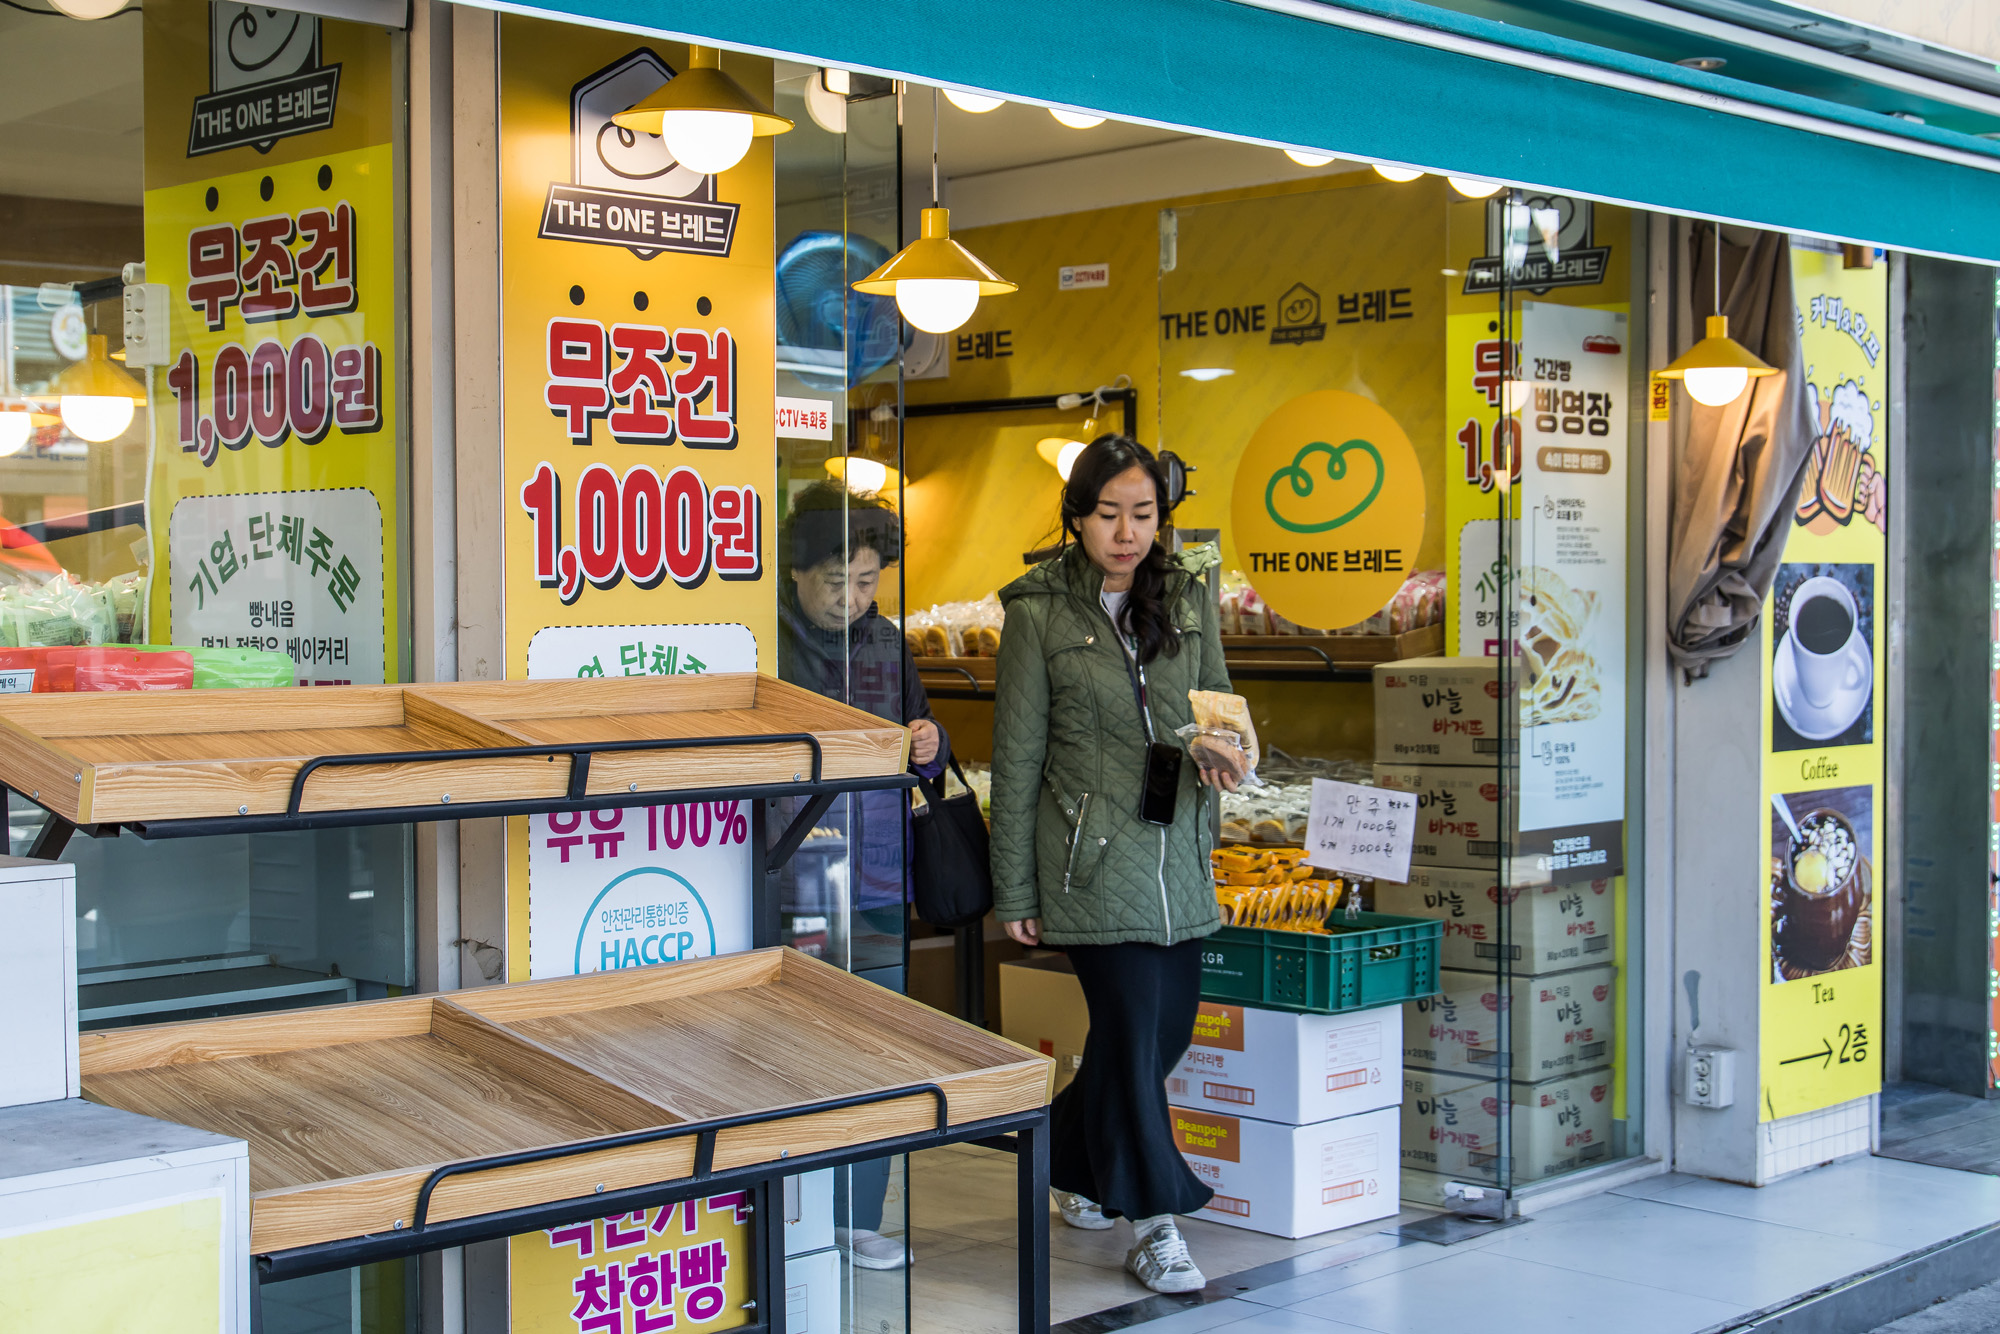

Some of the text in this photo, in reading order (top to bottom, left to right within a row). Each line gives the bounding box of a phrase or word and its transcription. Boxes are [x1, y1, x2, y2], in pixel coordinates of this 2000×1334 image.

[198, 84, 330, 138] THE ONE 브레드
[553, 199, 726, 243] THE ONE 브레드
[188, 200, 357, 331] 무조건
[1513, 262, 1548, 280] ONE
[1552, 257, 1600, 279] 브레드
[1160, 288, 1413, 340] THE ONE 브레드
[956, 330, 1014, 361] 브레드
[544, 317, 738, 449] 무조건
[167, 335, 382, 467] 1,000원
[1534, 387, 1612, 436] 빵명장
[776, 407, 827, 430] CTV녹화중
[520, 461, 762, 606] 1,000원
[189, 511, 362, 615] 기업,단체주문
[1250, 549, 1404, 573] THE ONE 브레드
[249, 600, 295, 628] 빵내음
[286, 636, 349, 665] 베이커리
[1422, 688, 1463, 715] 마늘
[1801, 758, 1839, 781] Coffee
[1418, 789, 1457, 816] 마늘
[547, 800, 748, 864] 우유 100%
[601, 901, 689, 933] 안전관리통합인증
[1424, 890, 1465, 917] 마늘
[600, 931, 694, 972] HACCP
[1417, 995, 1457, 1022] 마늘
[1811, 982, 1835, 1005] Tea
[1838, 1022, 1869, 1064] 2층
[1187, 1050, 1225, 1068] 키다리빵
[1417, 1097, 1459, 1125] 마늘
[1177, 1118, 1228, 1138] Beanpole
[1185, 1132, 1217, 1148] Bread
[570, 1238, 729, 1334] 착한빵
